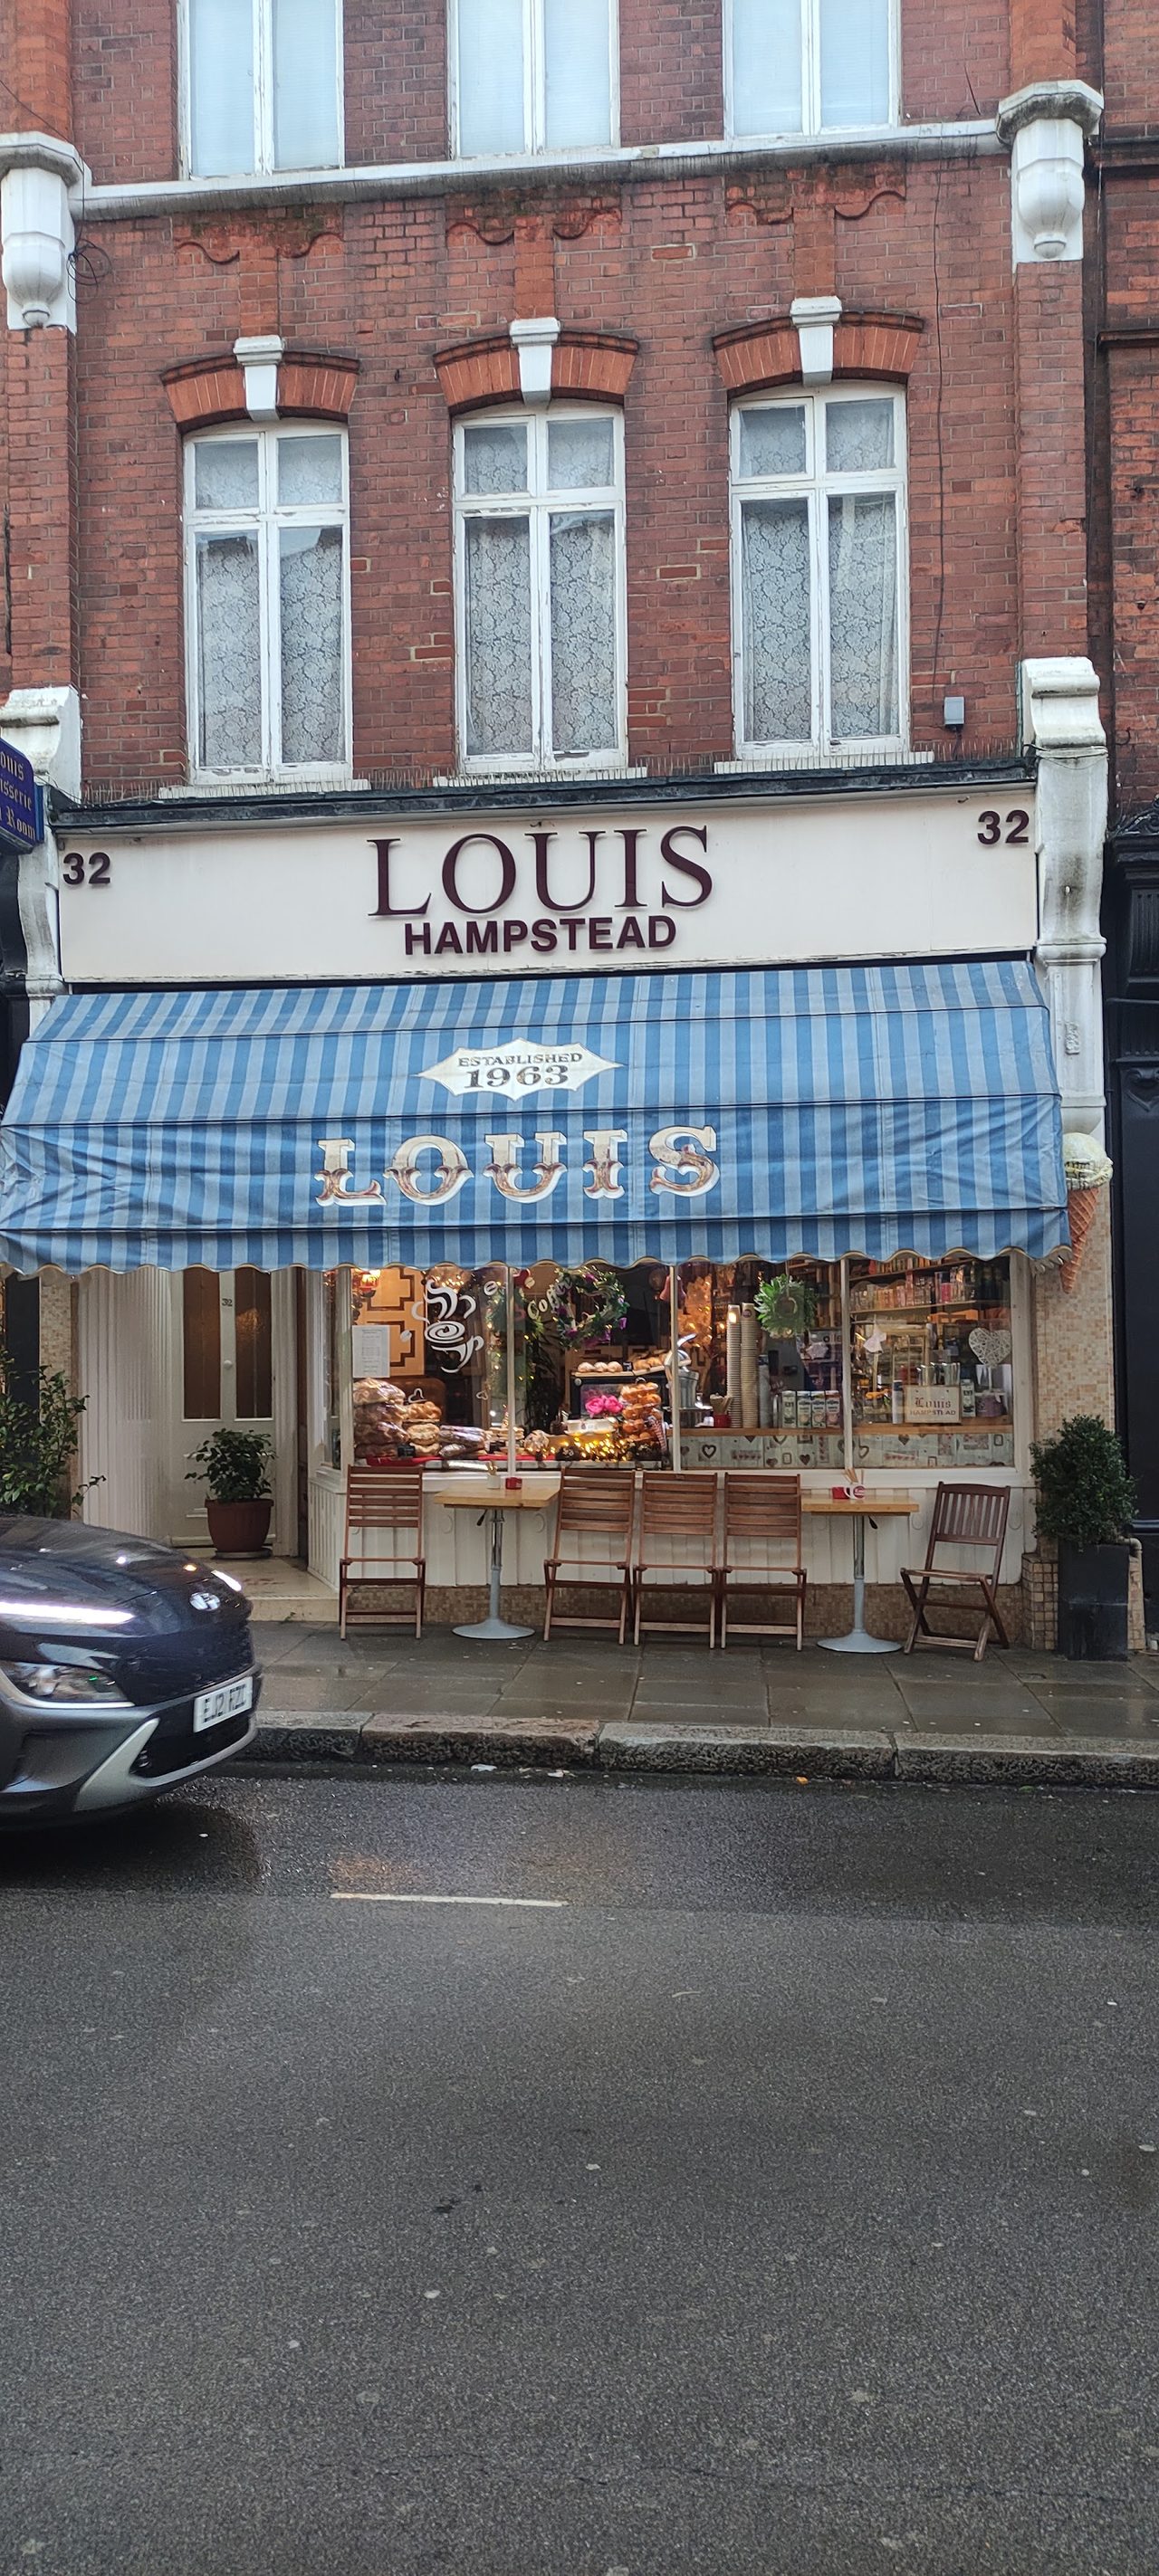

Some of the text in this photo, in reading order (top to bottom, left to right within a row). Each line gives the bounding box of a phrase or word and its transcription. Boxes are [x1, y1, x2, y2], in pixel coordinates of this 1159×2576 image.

[0, 751, 24, 781] ouis
[0, 779, 32, 811] isserie
[6, 805, 36, 841] Room
[976, 809, 1030, 845] 32
[62, 852, 111, 886] 32
[367, 825, 714, 917] LOUIS
[404, 914, 676, 956] HAMPSTEAD
[457, 1051, 584, 1068] ESTABLISHED
[464, 1064, 570, 1090] 1963
[315, 1124, 721, 1207] LOUIS
[221, 1297, 234, 1307] 32
[915, 1397, 952, 1409] Louis
